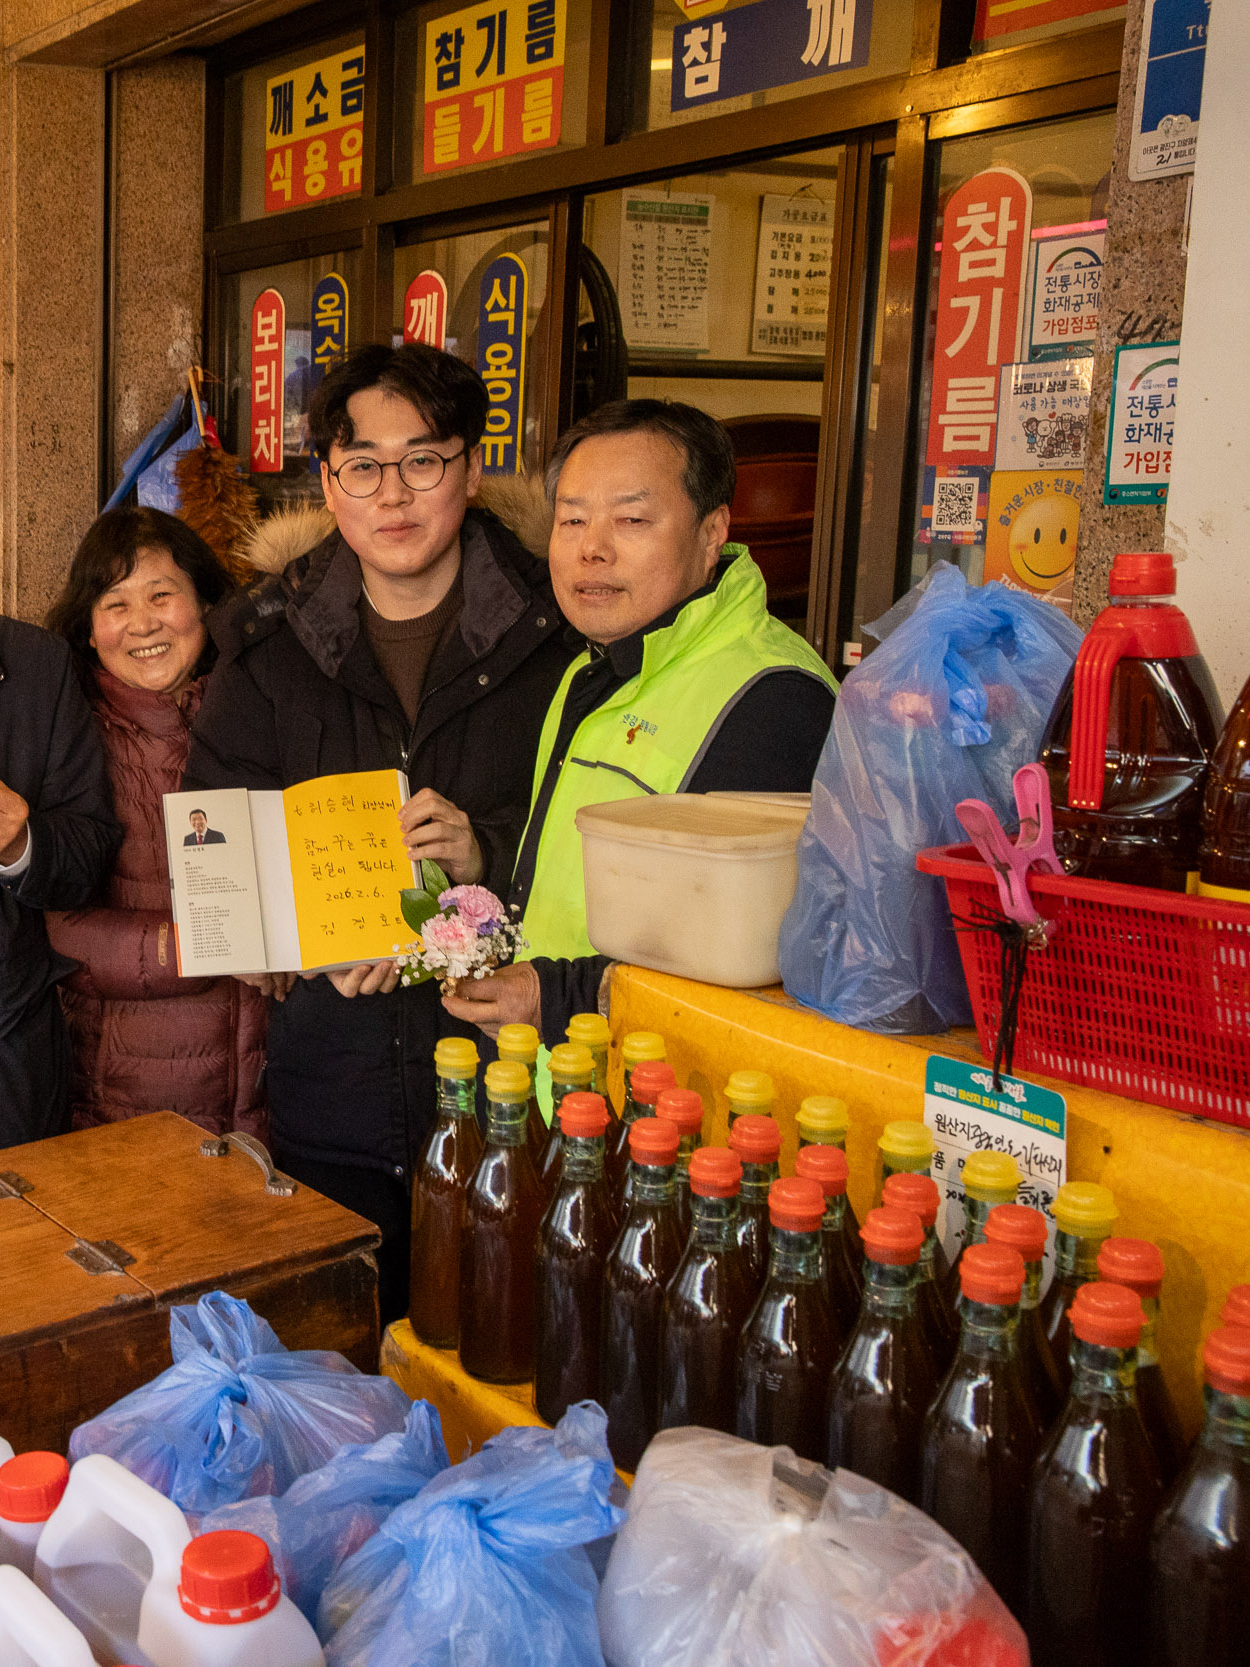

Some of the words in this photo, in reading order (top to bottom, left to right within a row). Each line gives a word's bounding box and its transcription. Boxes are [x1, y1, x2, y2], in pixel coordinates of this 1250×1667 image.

[434, 1, 556, 92] 참기름
[269, 56, 364, 136] 깨소금
[433, 77, 553, 164] 들기름
[269, 129, 363, 201] 식용유
[1043, 292, 1100, 313] 화재공제
[1044, 271, 1102, 294] 전통시장
[314, 292, 343, 373] 옥수
[407, 291, 439, 335] 깨
[938, 196, 1018, 452] 참기름
[1042, 315, 1098, 336] 가입점포
[253, 309, 279, 463] 보리차
[479, 275, 517, 467] 식용유
[1013, 382, 1044, 395] 코로나
[1046, 380, 1067, 393] 상생
[1020, 397, 1036, 412] 사용
[1040, 396, 1057, 410] 가능
[1024, 480, 1044, 497] 시장
[934, 1113, 970, 1141] 원산지
